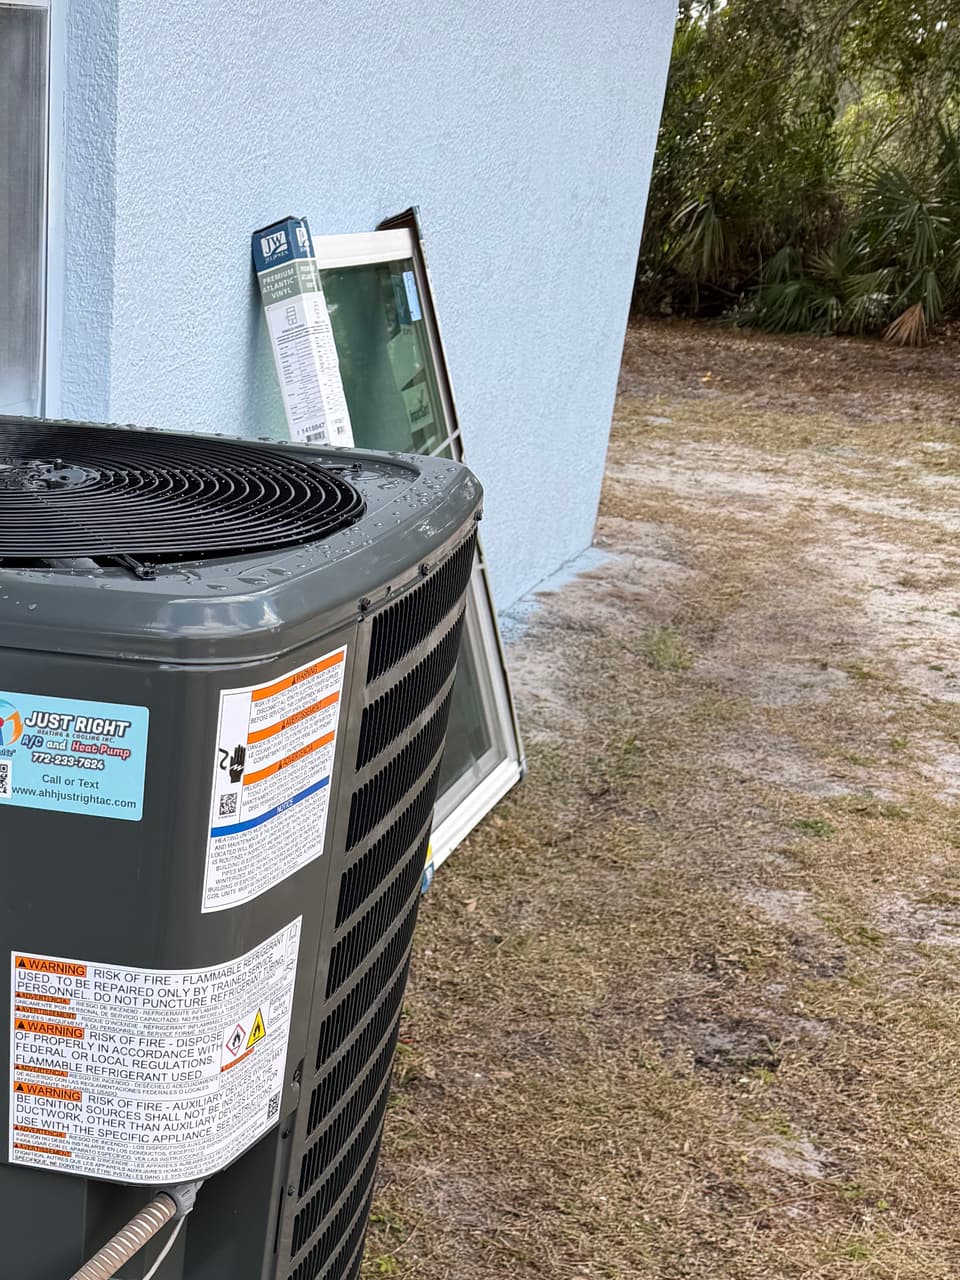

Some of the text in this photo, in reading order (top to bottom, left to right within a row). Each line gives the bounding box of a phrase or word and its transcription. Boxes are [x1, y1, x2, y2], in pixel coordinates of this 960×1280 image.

[263, 268, 294, 285] PREMIUM
[272, 288, 292, 299] VINYL
[25, 712, 130, 736] JUST RIGHT
[37, 730, 64, 738] HEATING
[72, 734, 100, 742] COOLING
[22, 735, 131, 760] A/C and Heat Pump
[32, 752, 105, 770] 772-233-7624
[42, 774, 61, 785] Call
[78, 778, 100, 790] Text
[12, 786, 137, 809] www.ahhjustrightac.com
[28, 960, 85, 976] WARNING
[94, 969, 120, 982] RISK
[124, 973, 141, 984] OF
[144, 976, 171, 986] FIRE
[183, 963, 242, 986] FLAMMABLE
[57, 976, 72, 987] TO
[76, 980, 90, 989] BE
[94, 982, 154, 997] REPAIRED
[158, 988, 190, 998] ONLY
[194, 985, 208, 996] BY
[212, 972, 246, 992] TRAINED
[248, 953, 274, 976] SERVICE
[17, 982, 90, 1000] PERSONNEL.
[94, 992, 111, 1002] DO
[114, 995, 138, 1006] NOT
[142, 998, 208, 1008] PUNCTURE
[16, 1032, 222, 1058] OF PROPERLY IN ACCORDANCE WITH
[28, 1022, 222, 1048] WARNING RISK OF FIRE DISPOSE
[16, 1043, 214, 1070] FEDERAL OR LOCAL REGULATIONS.
[16, 1054, 82, 1072] FLAMMABLE
[86, 1064, 168, 1081] REFRIGERANT
[16, 1095, 30, 1104] BE
[34, 1098, 82, 1112] IGNITION
[86, 1104, 141, 1120] SOURCES
[144, 1112, 182, 1122] SHALL
[184, 1109, 204, 1120] NOT
[208, 1103, 220, 1113] BE
[26, 1085, 80, 1102] WARNING
[88, 1095, 114, 1106] RISK
[117, 1099, 132, 1109] OF
[136, 1102, 162, 1112] FIRE
[172, 1092, 224, 1110] AUXILIARY
[16, 1116, 38, 1126] USE
[41, 1119, 70, 1132] WITH
[73, 1124, 94, 1136] THE
[98, 1128, 150, 1143] SPECIFIC
[216, 1118, 230, 1132] SEE
[87, 1116, 126, 1129] OTHER
[130, 1122, 160, 1132] THAN
[162, 1114, 216, 1131] AUXILIARY
